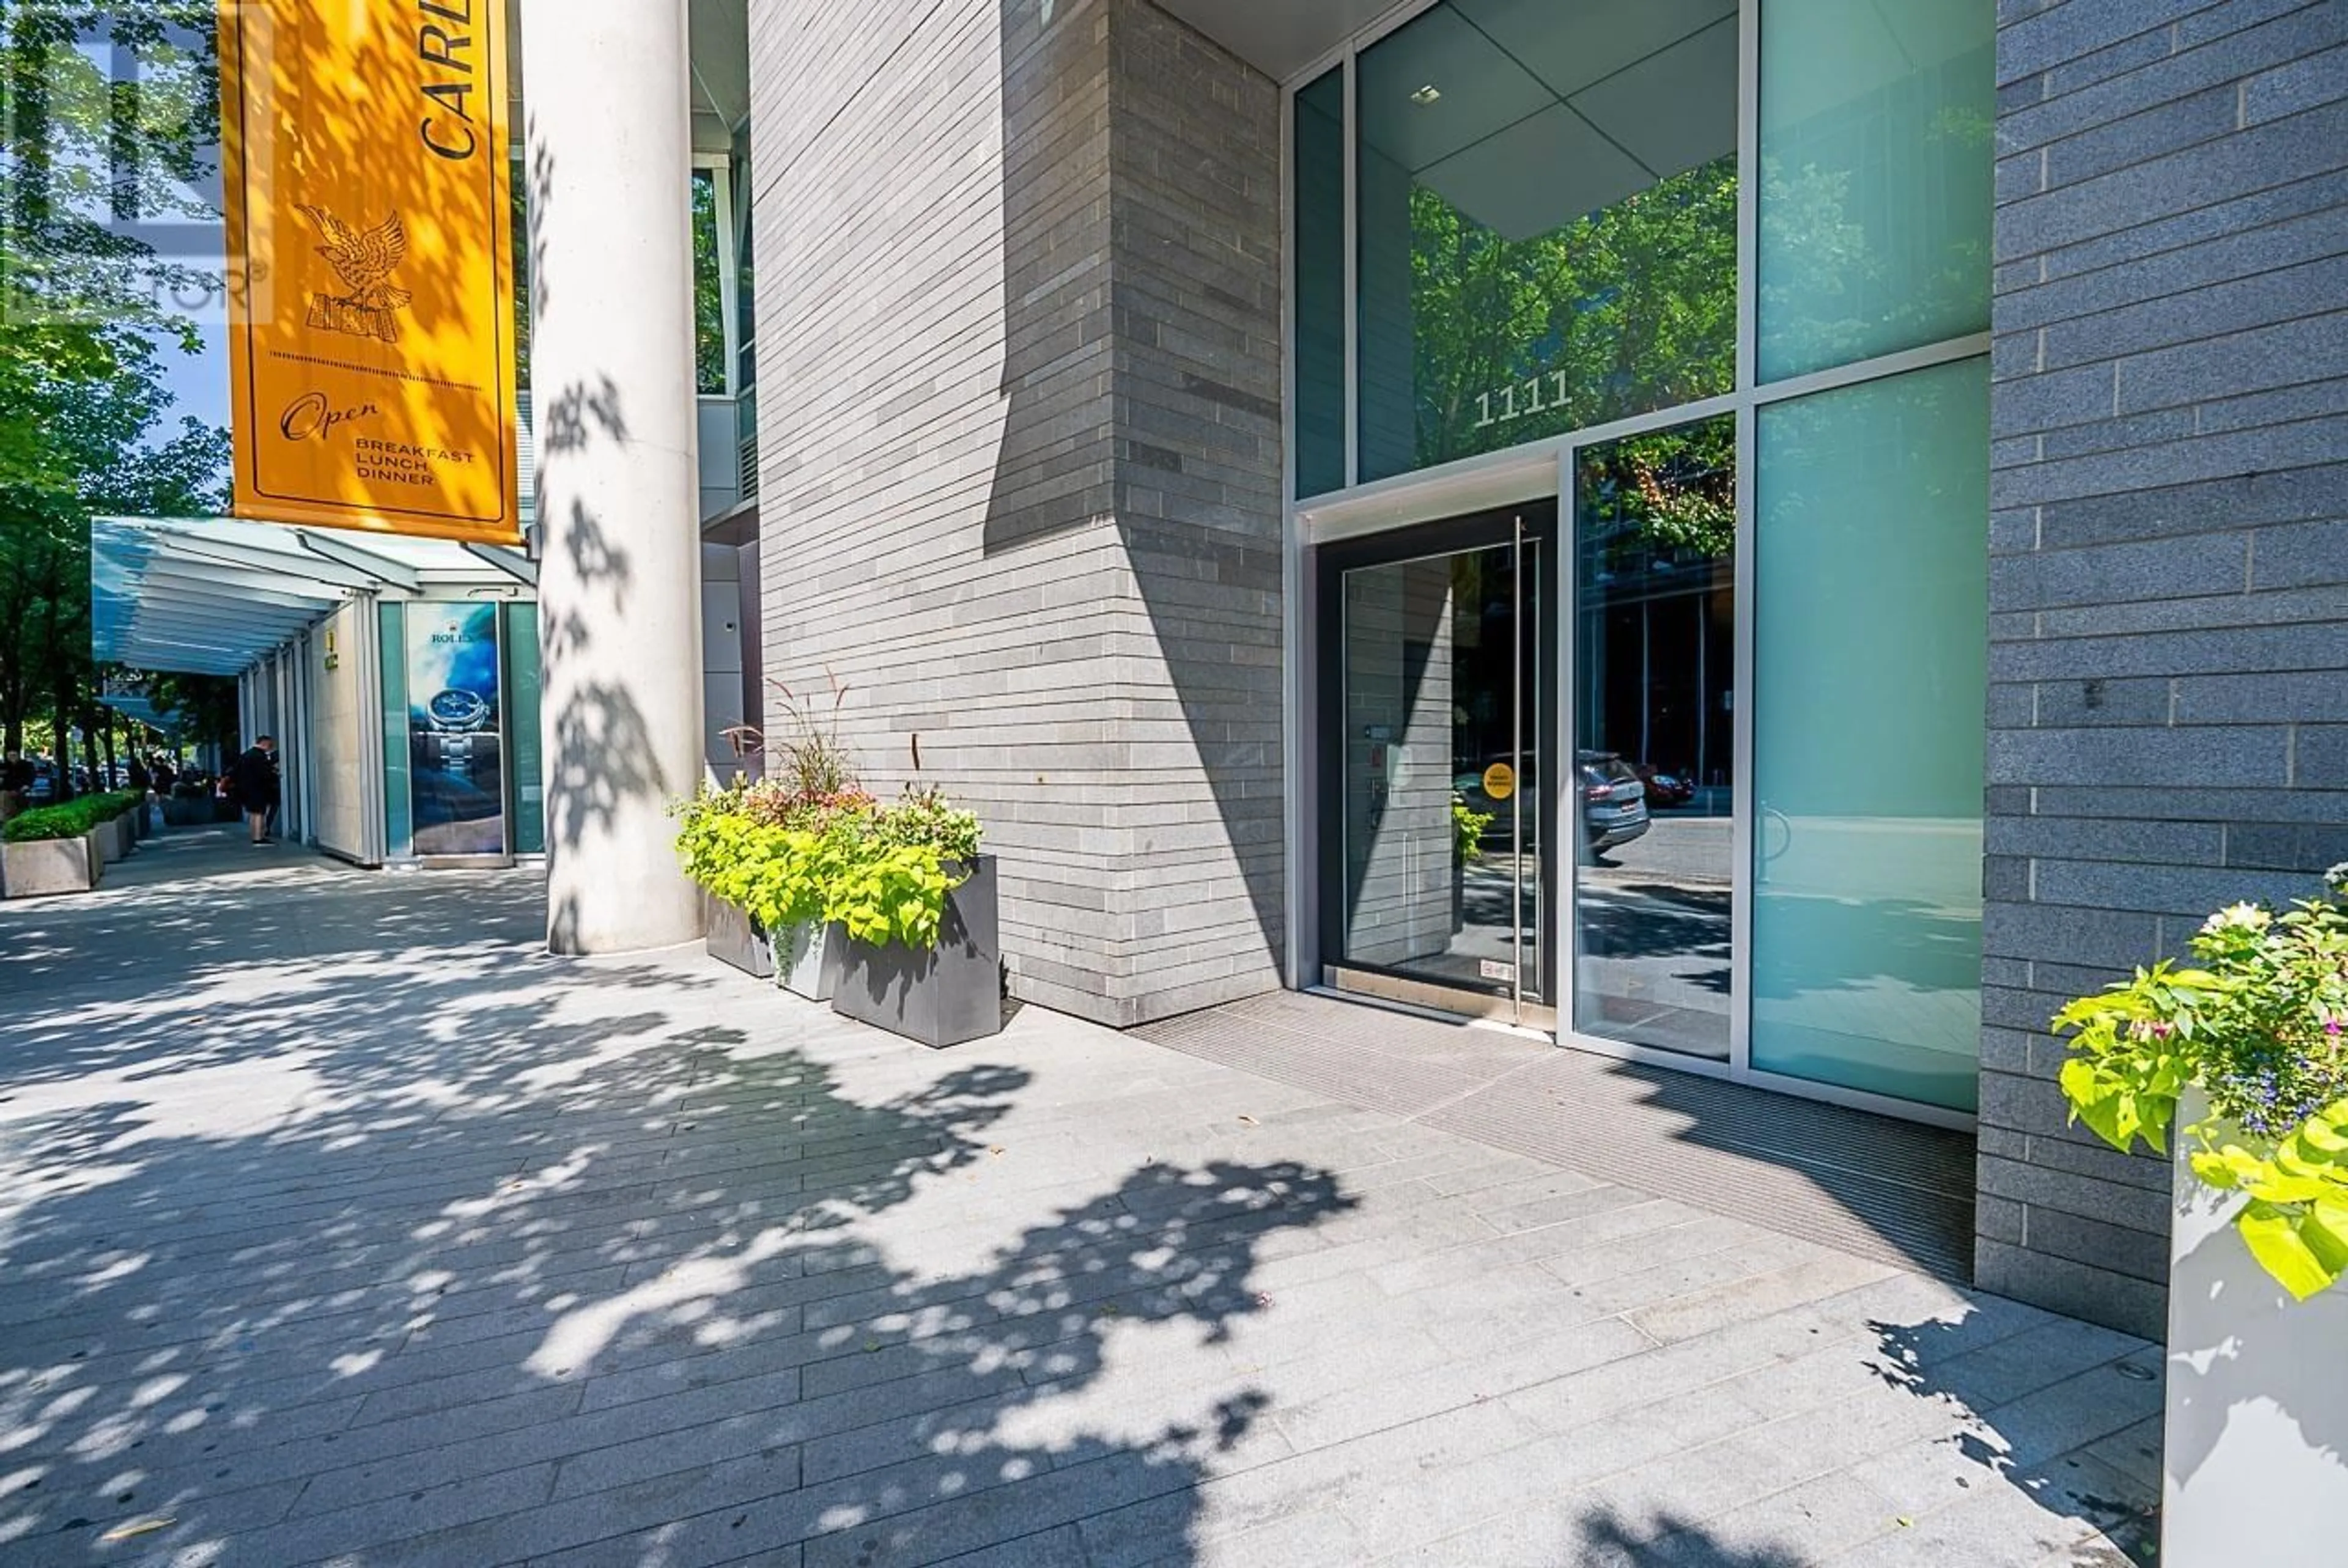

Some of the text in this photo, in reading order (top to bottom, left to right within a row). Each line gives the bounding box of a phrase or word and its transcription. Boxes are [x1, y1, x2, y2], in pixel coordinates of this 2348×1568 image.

[418, 0, 475, 160] CARL
[280, 392, 378, 441] Open
[1474, 369, 1573, 427] 1111
[356, 438, 475, 463] BREAKFAST
[356, 453, 427, 471] LUNCH
[357, 467, 434, 485] DINNER
